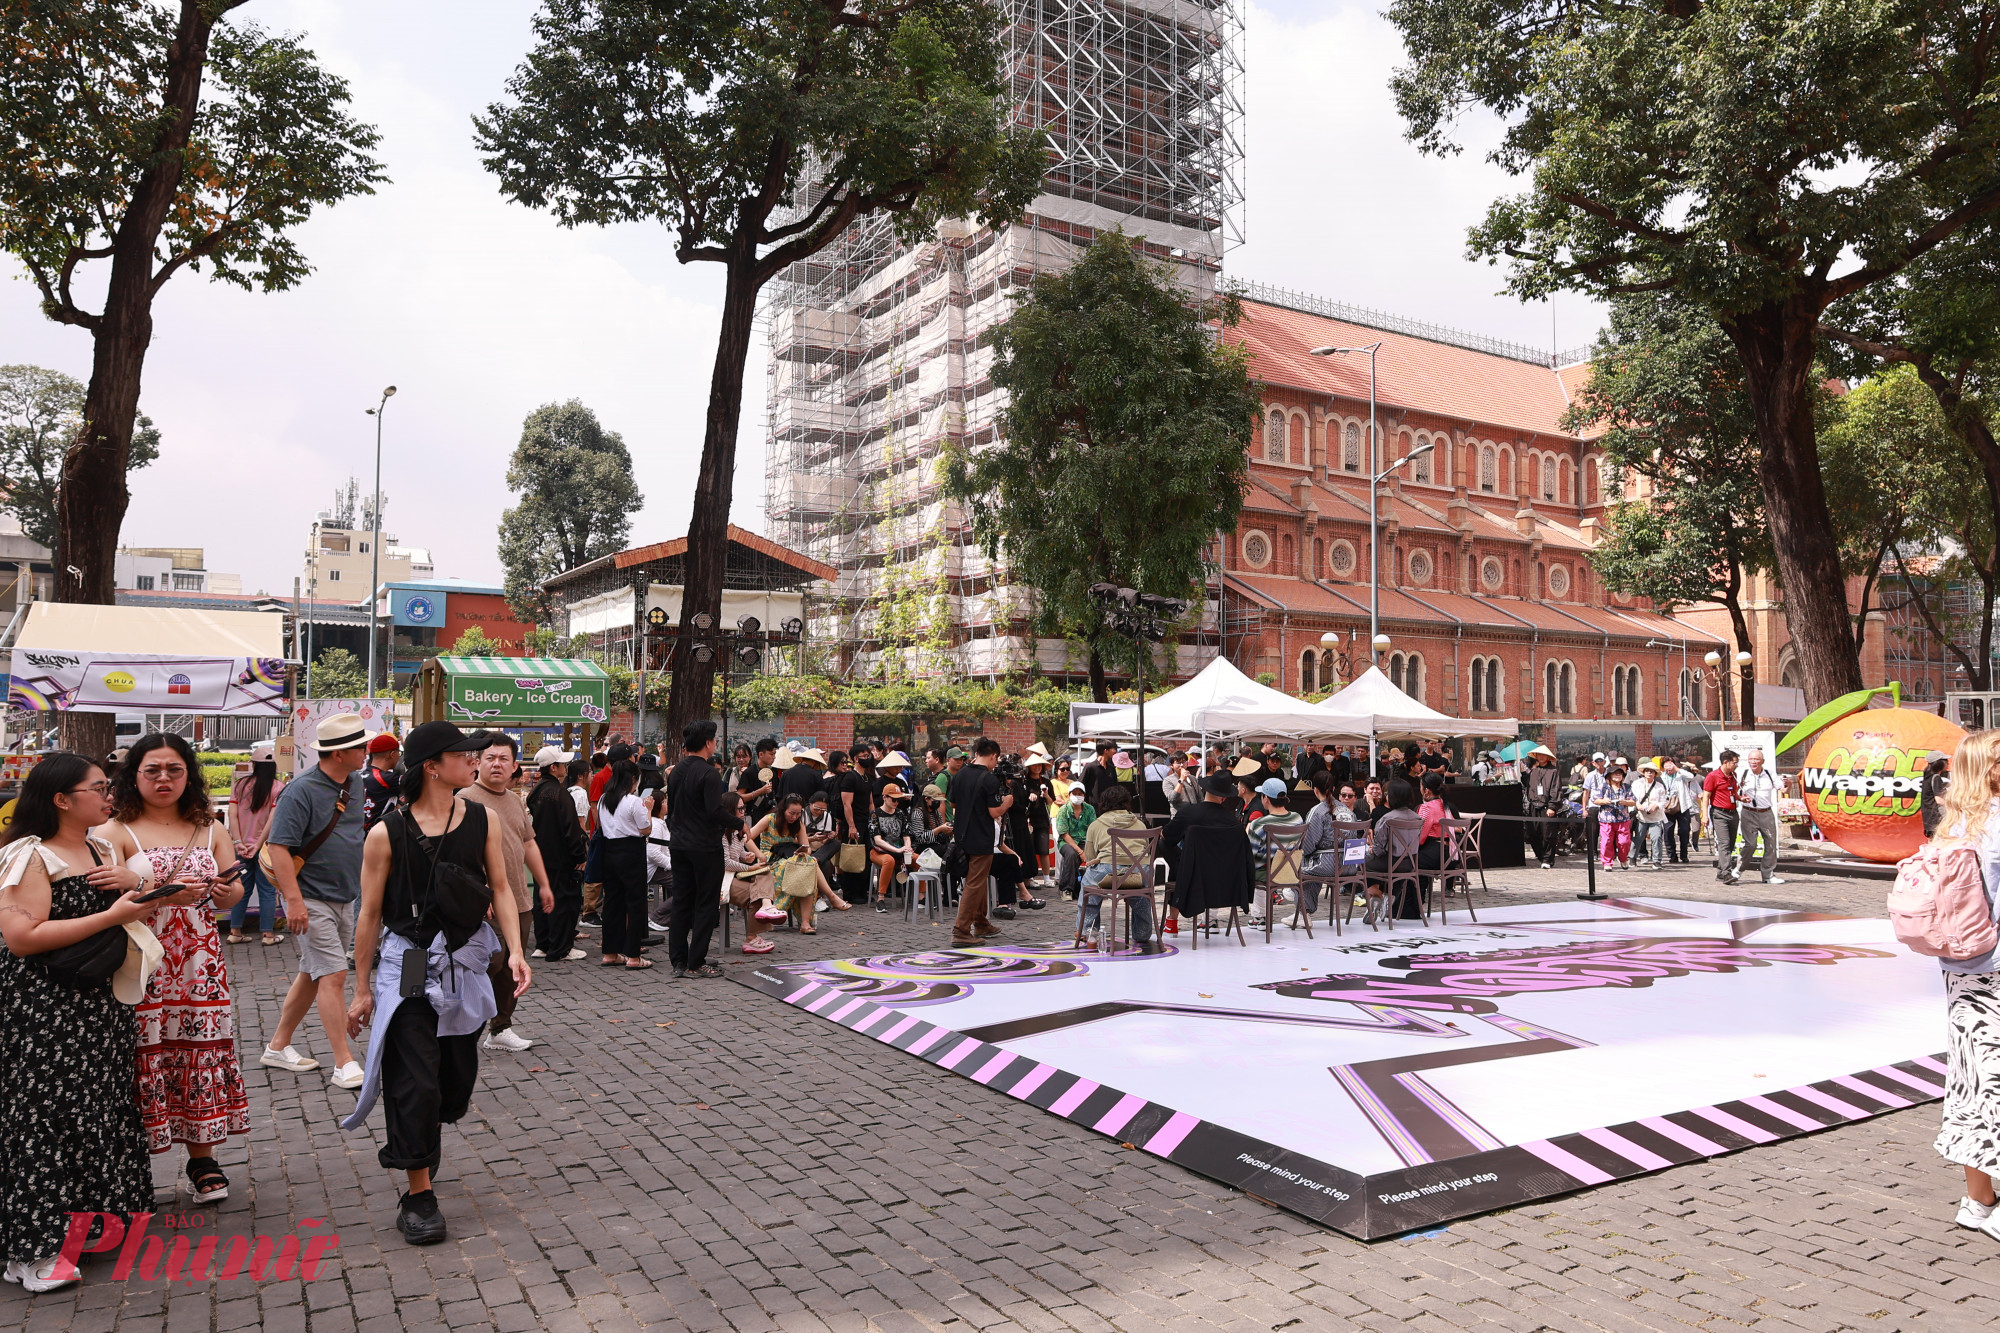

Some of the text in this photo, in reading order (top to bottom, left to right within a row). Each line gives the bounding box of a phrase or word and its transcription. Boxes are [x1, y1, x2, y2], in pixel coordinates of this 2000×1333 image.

[464, 689, 514, 705] Bakery
[526, 691, 546, 703] Ice
[550, 692, 593, 704] Cream
[1237, 1153, 1350, 1201] Please mind your step
[1378, 1171, 1499, 1204] Please mind your step
